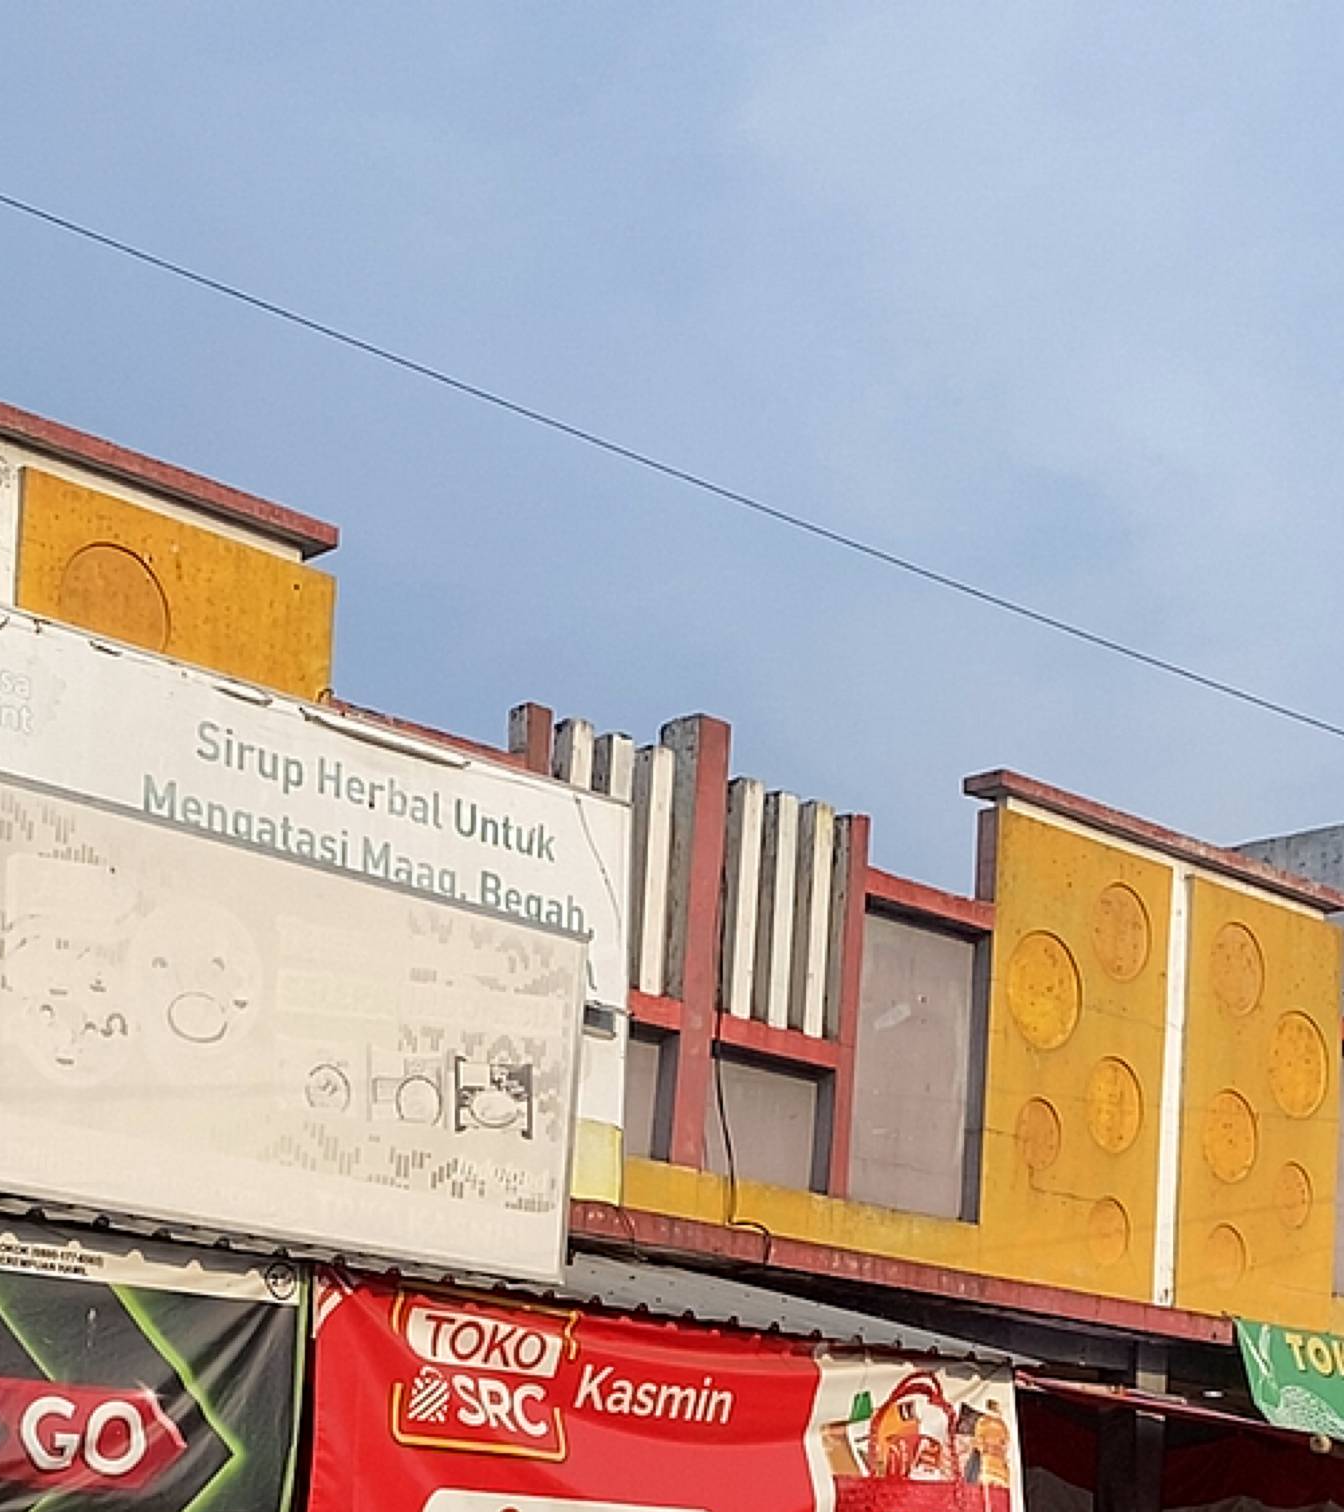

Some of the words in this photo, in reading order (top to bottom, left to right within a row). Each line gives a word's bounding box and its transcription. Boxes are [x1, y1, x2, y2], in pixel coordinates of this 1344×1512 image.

[142, 774, 351, 868] Mengatasi
[195, 720, 305, 790] Sirup
[316, 756, 442, 830] Herbal
[453, 799, 558, 863] Untuk
[424, 1313, 547, 1370] TOKO
[451, 1374, 549, 1438] SRC
[573, 1363, 734, 1426] Kasmin
[20, 1396, 149, 1476] GO
